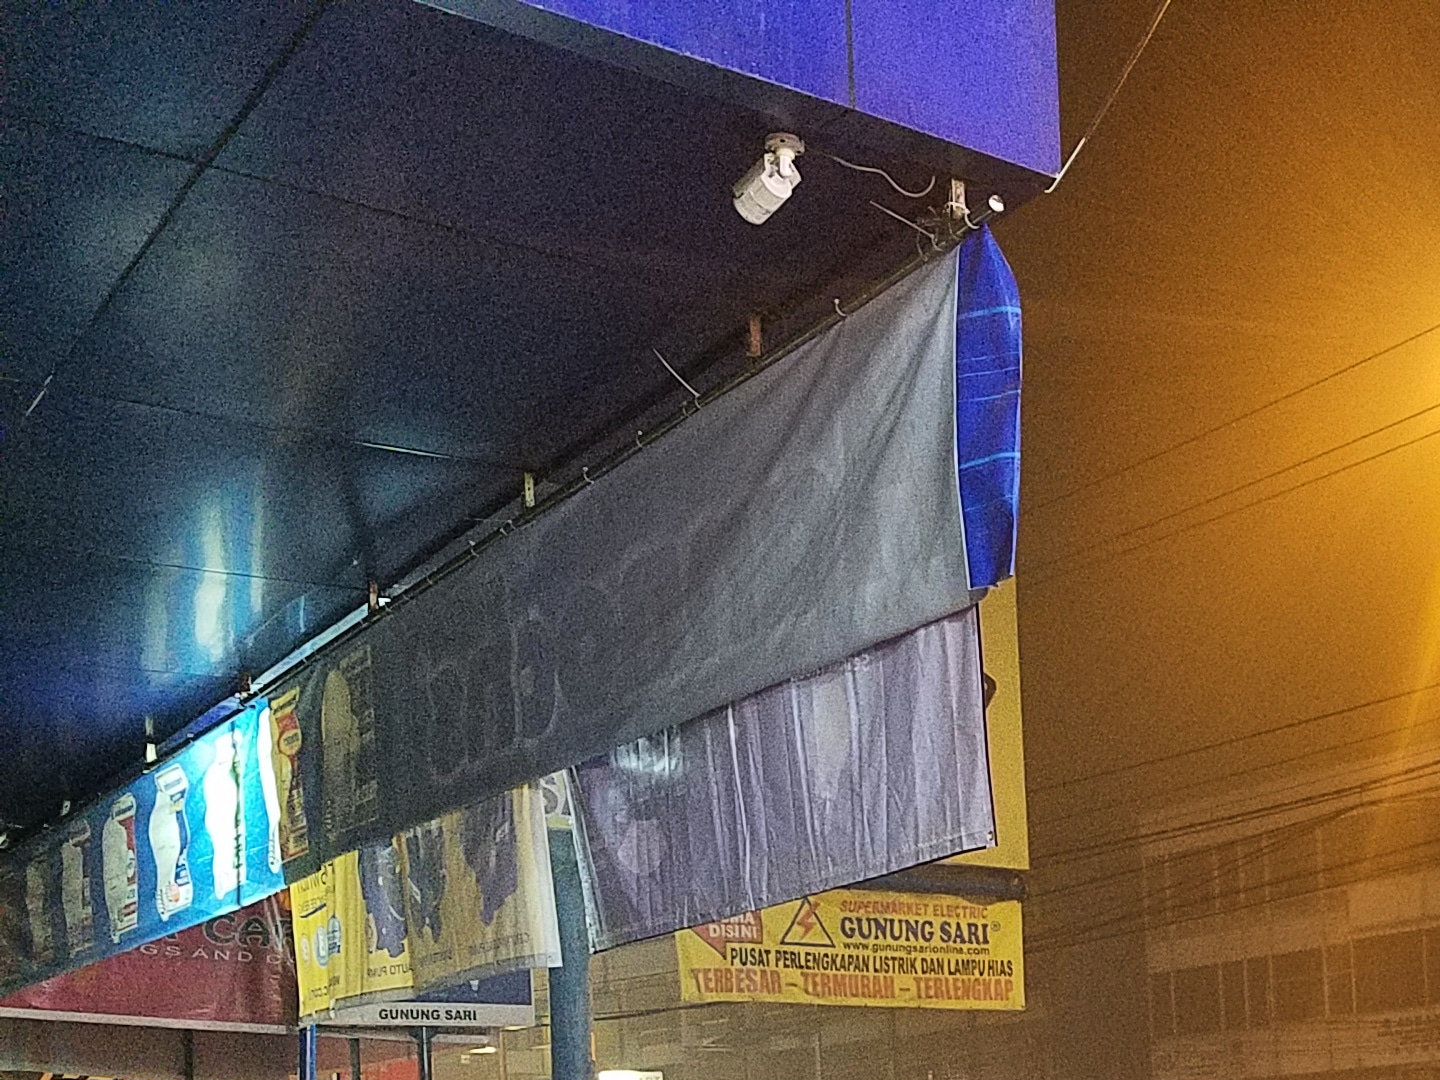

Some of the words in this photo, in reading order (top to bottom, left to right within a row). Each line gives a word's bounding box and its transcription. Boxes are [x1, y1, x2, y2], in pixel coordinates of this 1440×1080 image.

[840, 900, 929, 917] SUPERMARKET
[932, 904, 988, 919] ELECTRIC
[709, 925, 757, 939] DISINI
[840, 916, 934, 943] GUNUNG
[939, 920, 990, 945] SARI
[140, 943, 180, 956] GS
[191, 945, 253, 962] AND
[730, 947, 771, 967] PUSAT
[775, 951, 870, 973] PERLENGKAPAN
[872, 955, 918, 975] LISTRIK
[920, 957, 944, 976] DAN
[947, 958, 985, 977] LAMPU
[987, 959, 1014, 977] HIAS
[691, 967, 782, 994] TERBESAR
[801, 971, 895, 999] TERMURAH
[912, 975, 1014, 1001] TERLENGKAP
[378, 1008, 442, 1022] GUNUNG
[445, 1009, 478, 1022] SARI
